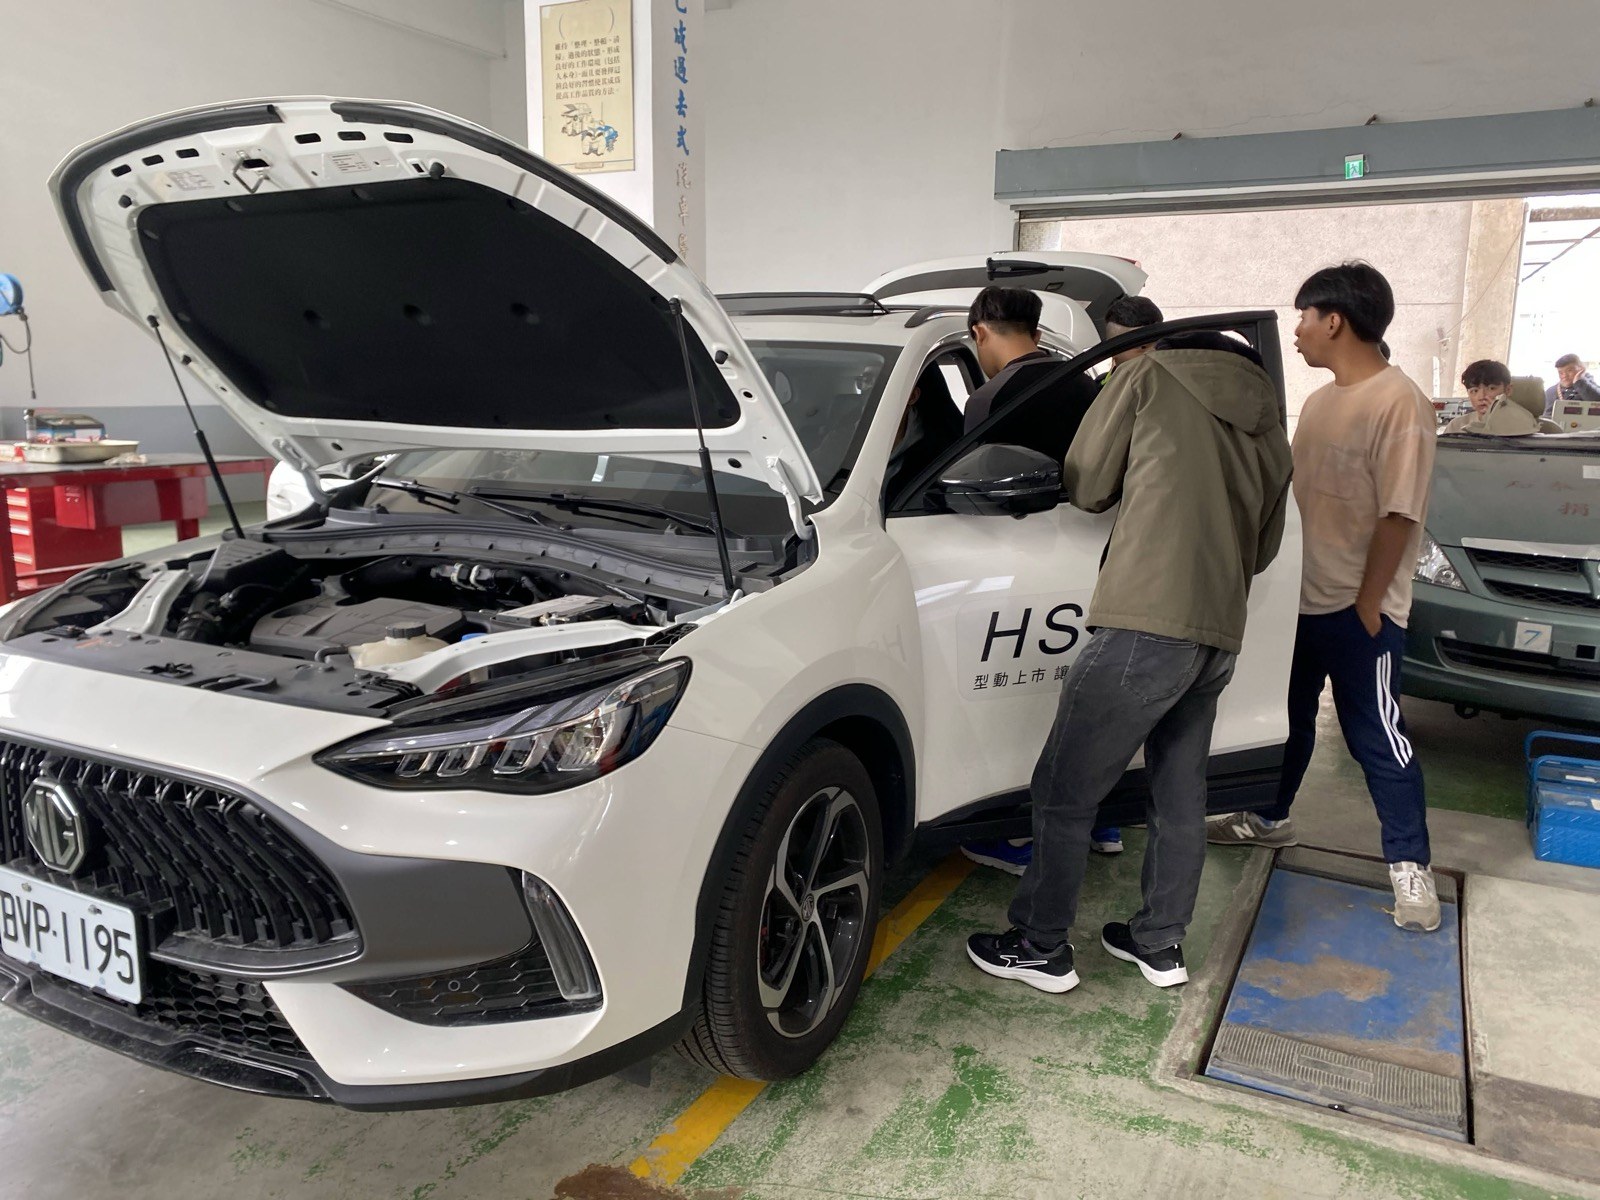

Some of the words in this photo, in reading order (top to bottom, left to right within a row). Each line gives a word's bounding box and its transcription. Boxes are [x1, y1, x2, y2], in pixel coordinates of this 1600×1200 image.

[980, 603, 1084, 662] HS
[1524, 629, 1543, 646] 7
[973, 667, 1047, 691] 型動上市
[25, 789, 77, 867] MG
